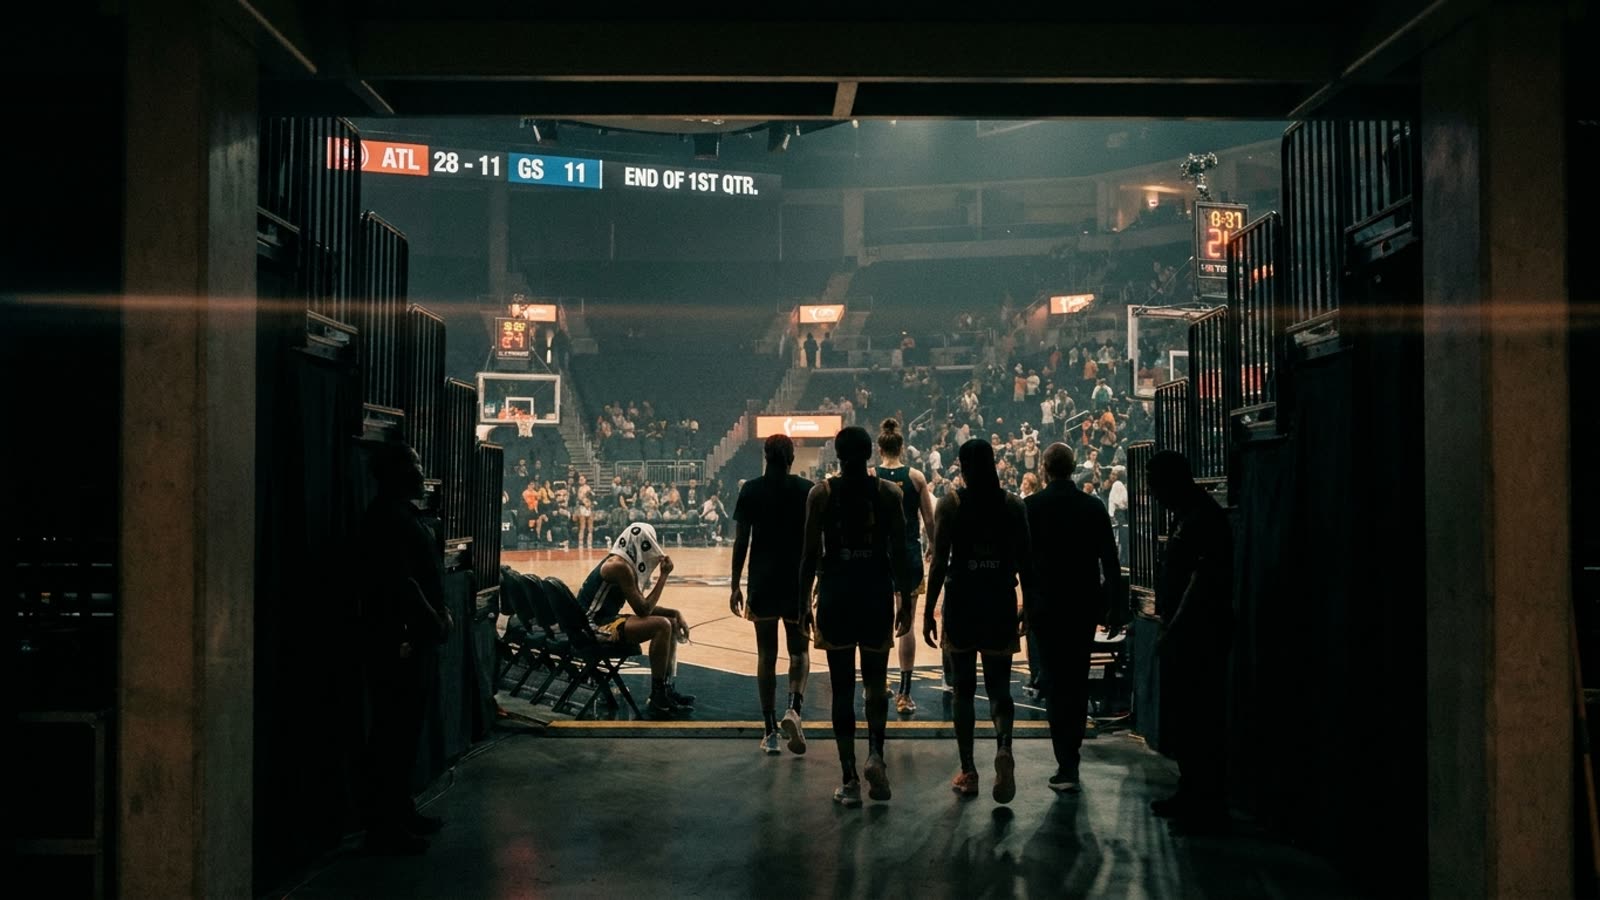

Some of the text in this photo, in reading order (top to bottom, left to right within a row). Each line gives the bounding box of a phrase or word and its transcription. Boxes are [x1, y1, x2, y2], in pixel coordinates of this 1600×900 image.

[381, 147, 420, 170] ATL
[433, 151, 459, 173] 28
[478, 155, 500, 176] 11
[517, 157, 545, 180] GS
[564, 161, 585, 183] 11
[624, 166, 659, 188] END
[663, 170, 685, 190] OF
[688, 172, 719, 192] 1ST
[722, 174, 759, 196] QTR.
